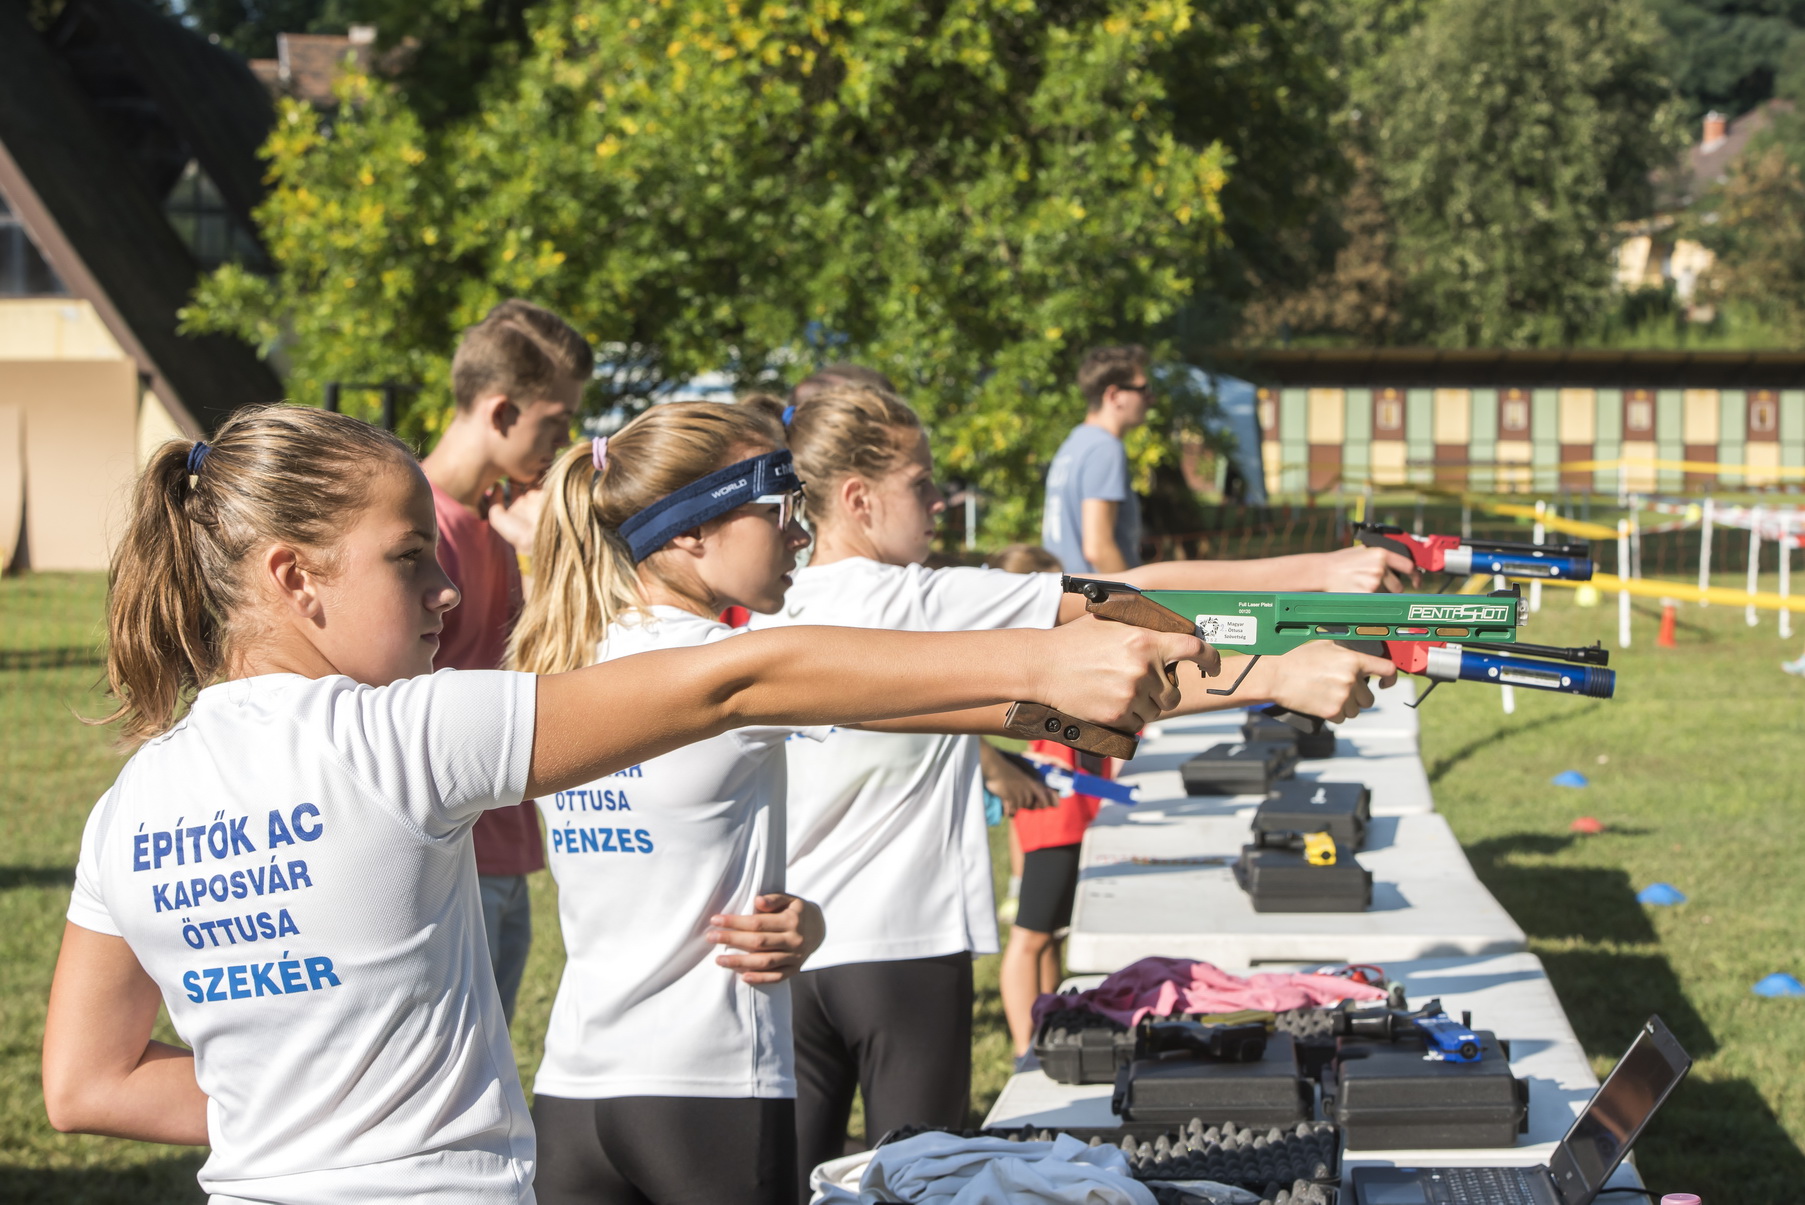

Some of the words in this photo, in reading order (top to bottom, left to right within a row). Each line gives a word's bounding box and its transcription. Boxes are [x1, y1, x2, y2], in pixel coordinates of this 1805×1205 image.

[711, 478, 748, 499] WORLD
[133, 809, 256, 872] ÉPÍTŐK
[268, 803, 323, 849] AC
[552, 820, 654, 854] PÉNZES
[152, 855, 313, 913] KAPOSVÁR
[182, 908, 300, 950] ÖTTUSA
[182, 950, 342, 1004] SZEKÉR
